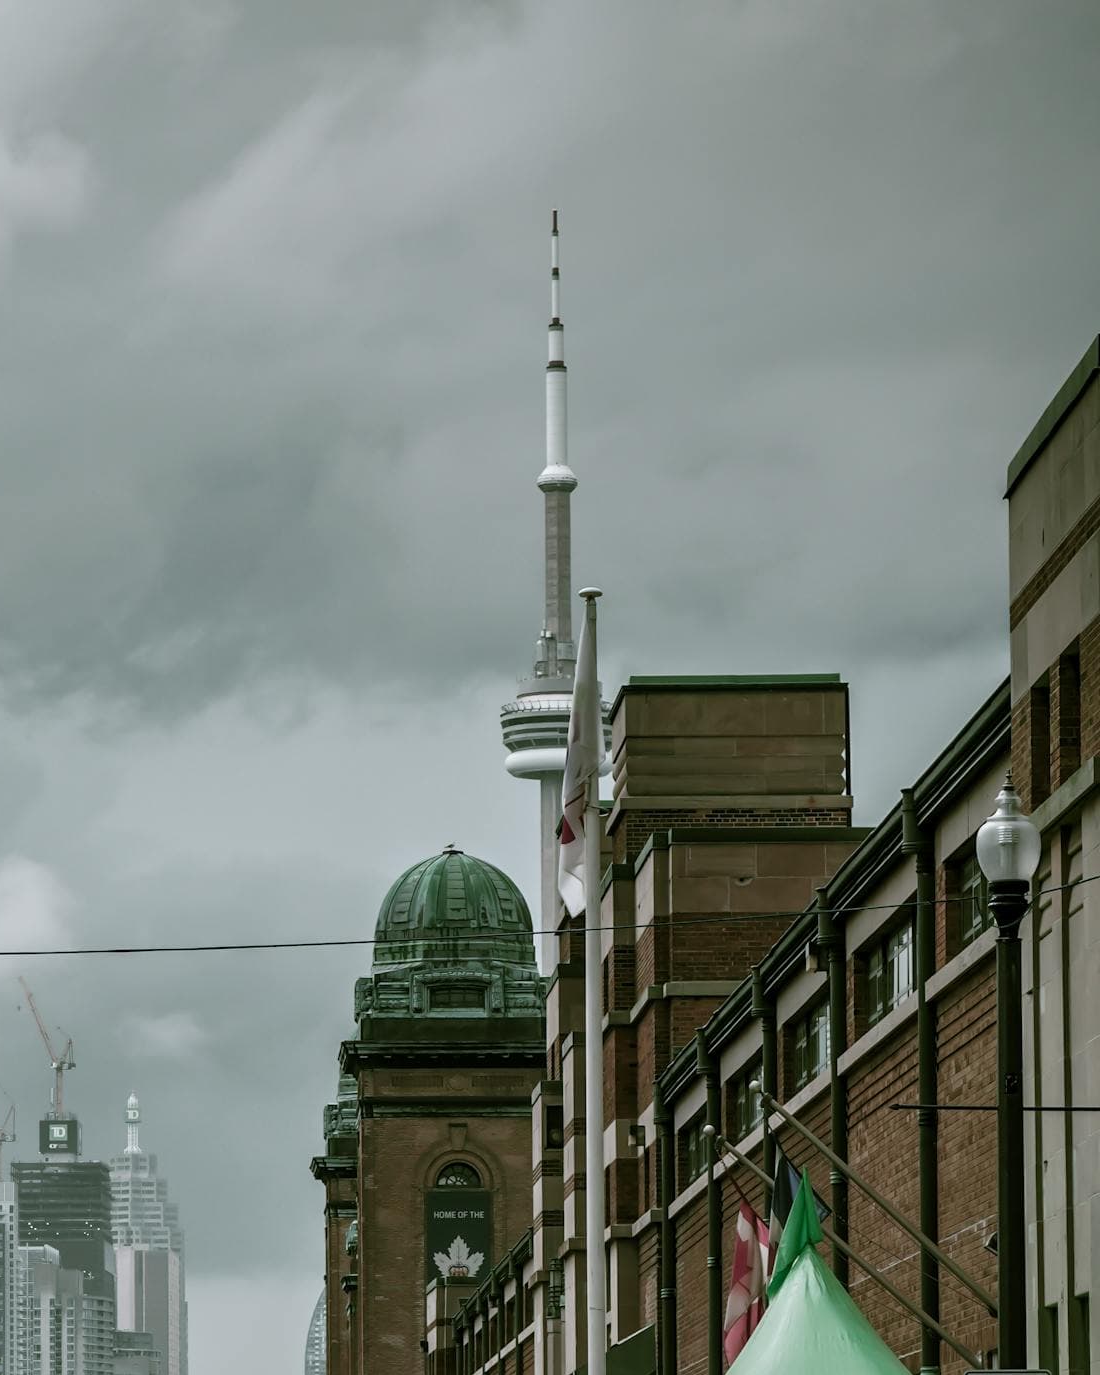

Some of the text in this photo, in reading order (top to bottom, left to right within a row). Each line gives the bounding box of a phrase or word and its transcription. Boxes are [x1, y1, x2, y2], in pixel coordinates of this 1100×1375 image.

[126, 1109, 140, 1120] TD
[51, 1126, 66, 1138] TD
[433, 1211, 485, 1219] HOME OF THE
